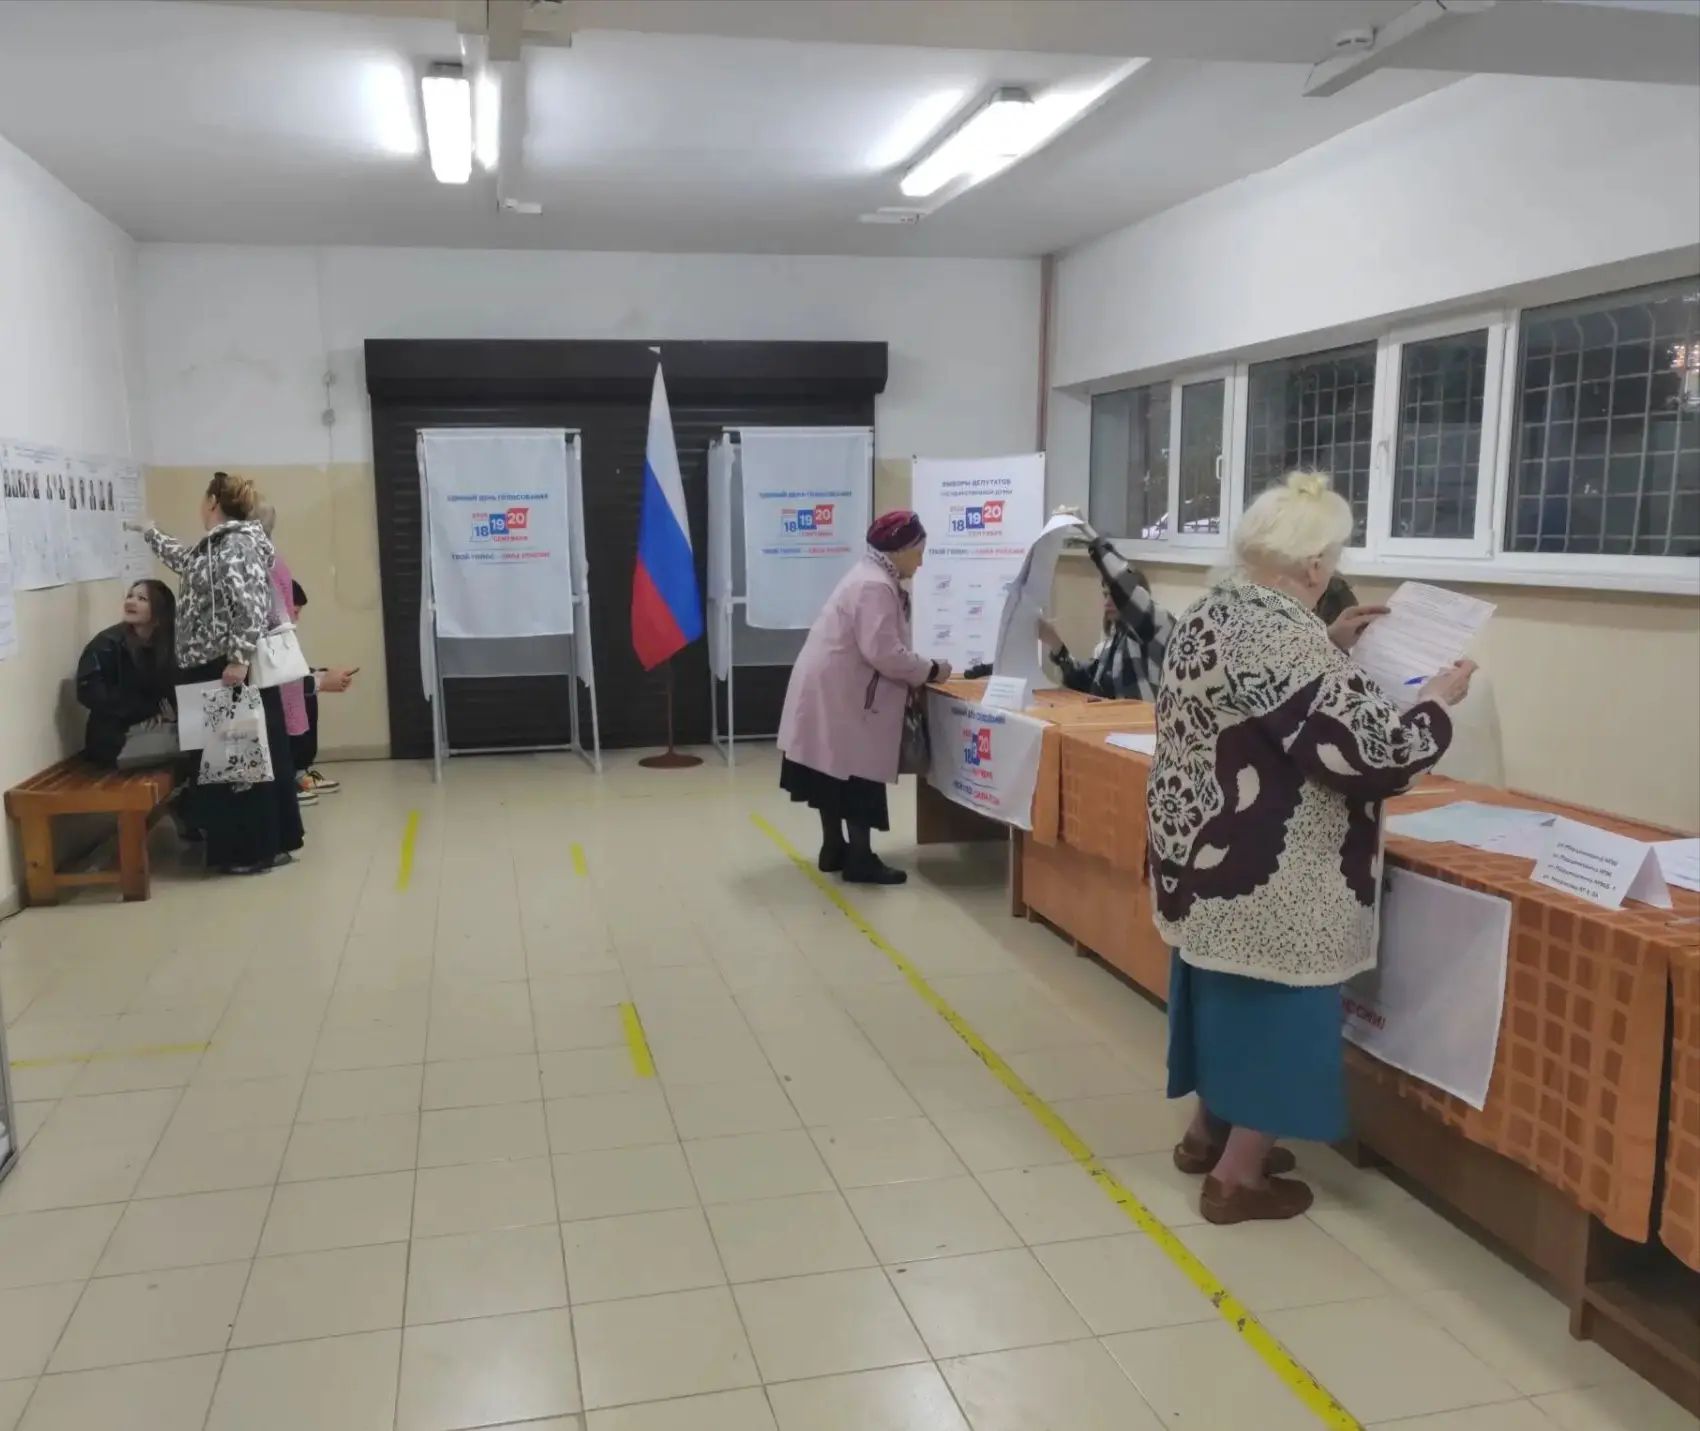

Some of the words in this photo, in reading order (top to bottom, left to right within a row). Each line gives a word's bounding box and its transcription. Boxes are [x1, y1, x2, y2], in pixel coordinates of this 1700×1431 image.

[474, 525, 489, 537] 18
[491, 518, 505, 531] 19
[507, 512, 525, 525] 20
[784, 521, 797, 533] 18
[799, 514, 813, 526] 19
[815, 508, 831, 521] 20
[952, 519, 965, 531] 18
[967, 512, 981, 525] 19
[983, 505, 1002, 518] 20
[978, 735, 989, 754] 20
